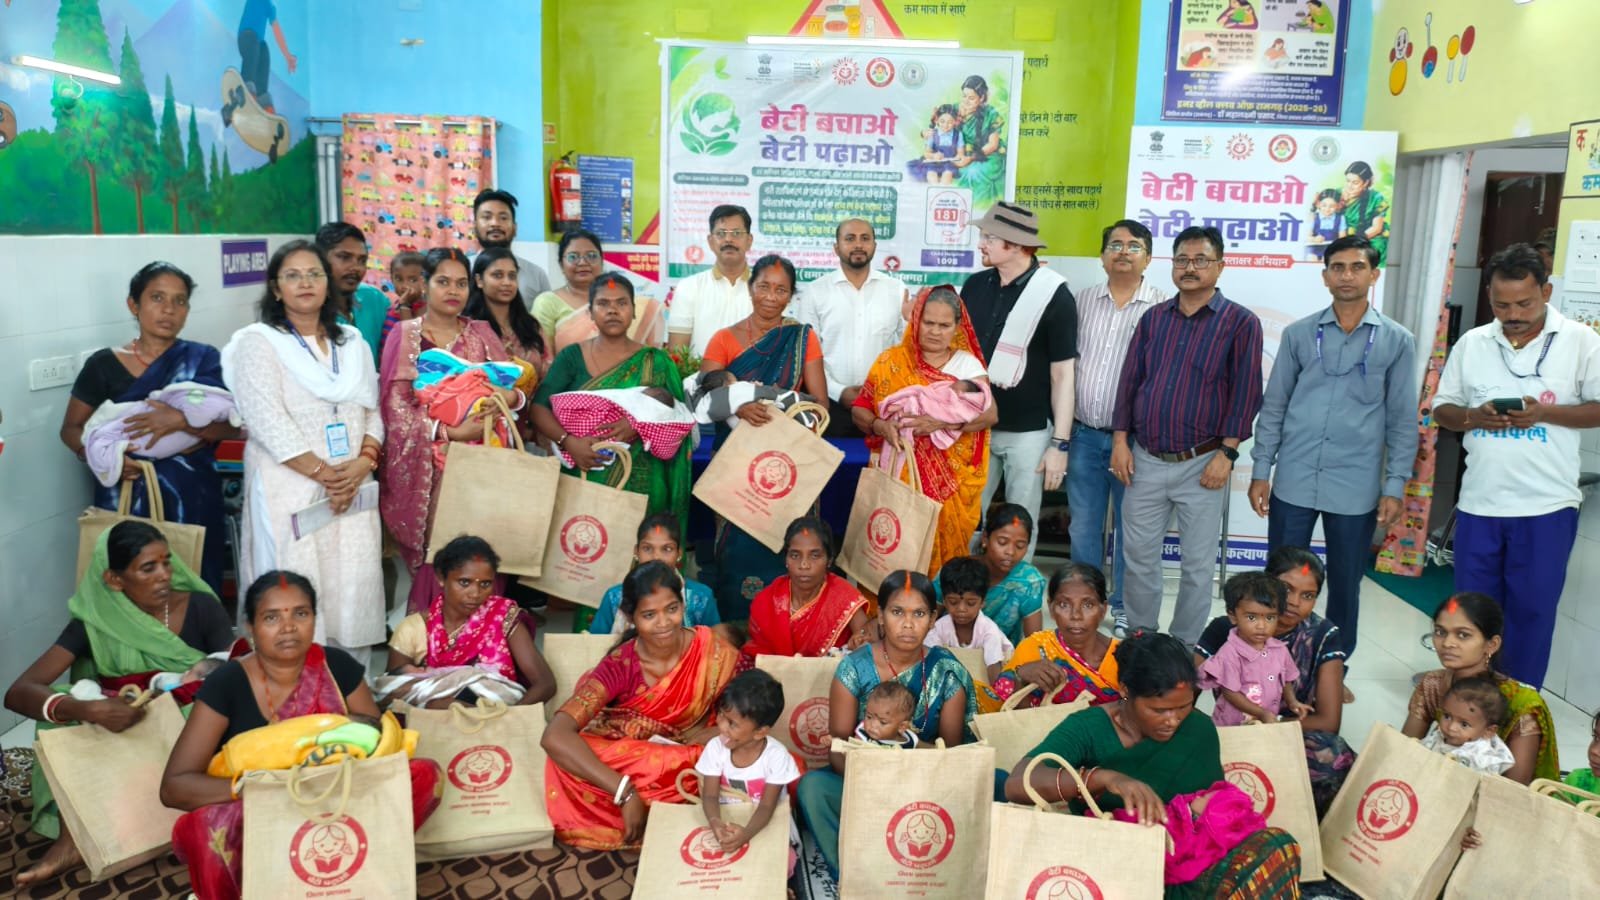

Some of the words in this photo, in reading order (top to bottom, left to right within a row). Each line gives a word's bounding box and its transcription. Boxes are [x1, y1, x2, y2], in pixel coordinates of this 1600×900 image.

[760, 103, 809, 132] बेटी
[814, 107, 898, 136] बचाओ
[760, 135, 808, 162] बेटी
[814, 138, 894, 167] पढ़ाओ
[1141, 171, 1197, 202] बेटी
[1205, 175, 1308, 205] बचाओ
[936, 210, 958, 220] 181
[223, 253, 250, 274] PLAYING
[251, 252, 267, 272] AREA
[937, 257, 958, 266] 1098
[1224, 255, 1251, 267] स्ताक्षर
[1253, 256, 1289, 267] अभियान
